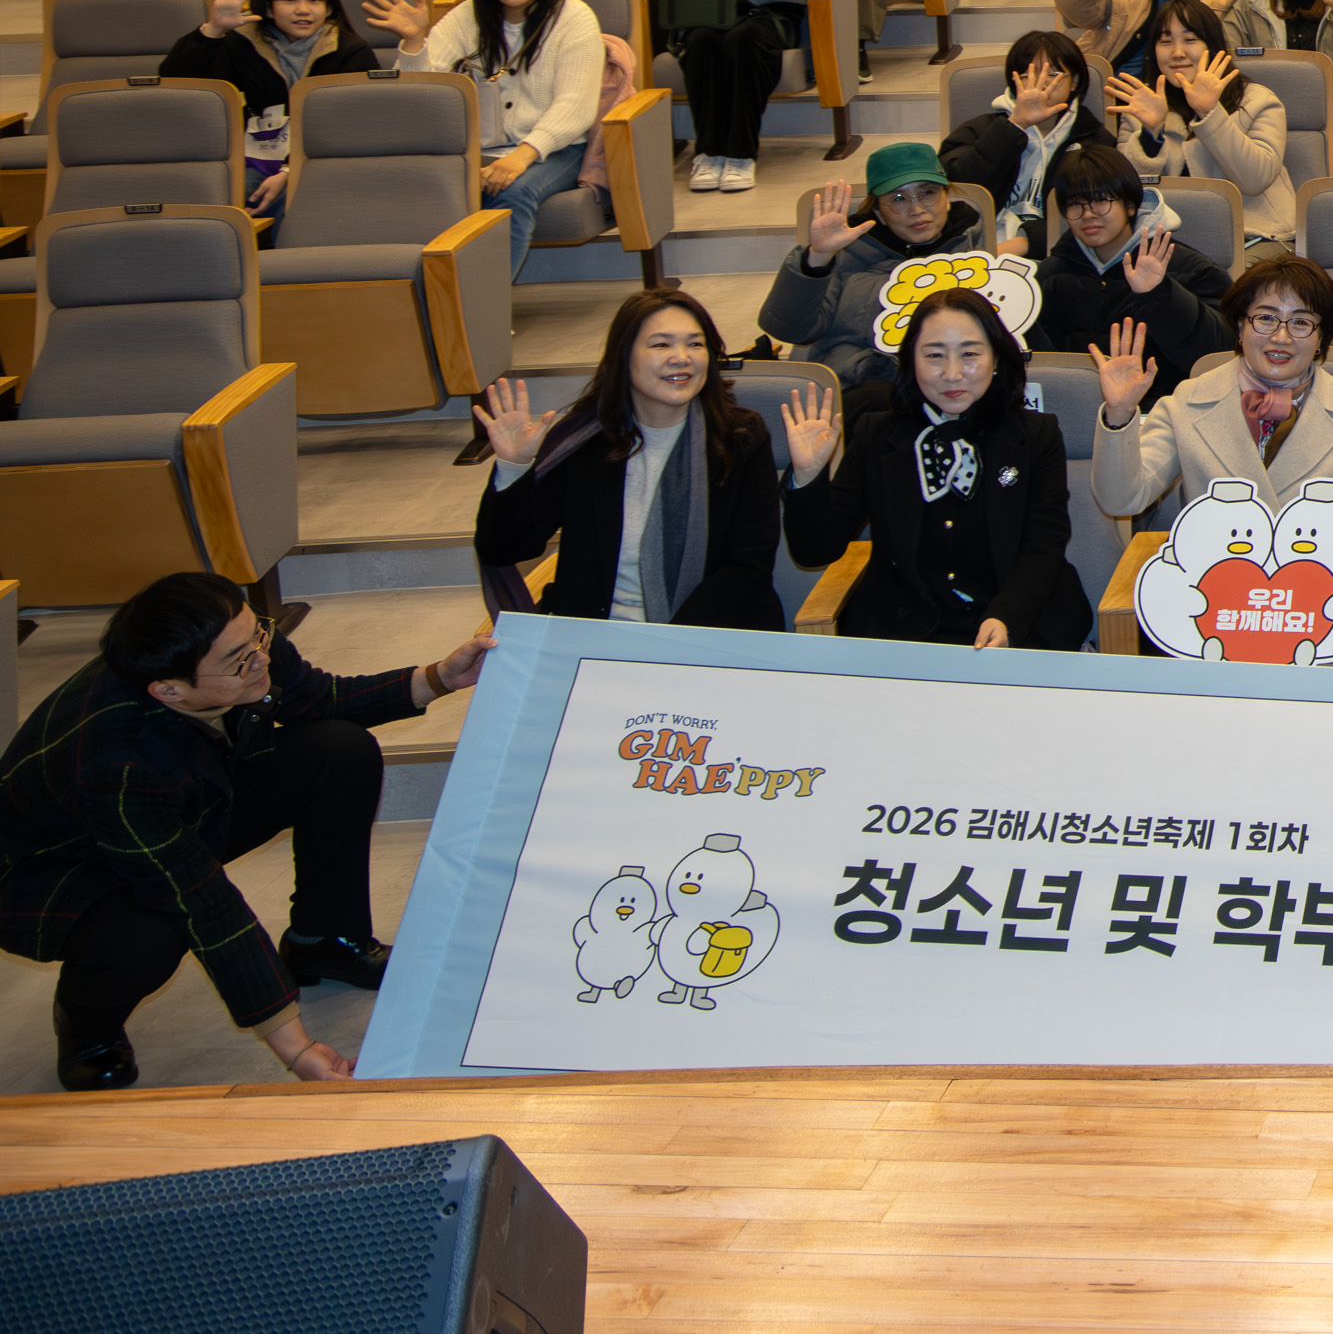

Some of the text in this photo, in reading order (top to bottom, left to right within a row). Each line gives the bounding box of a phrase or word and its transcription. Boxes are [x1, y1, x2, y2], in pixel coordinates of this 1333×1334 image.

[1247, 588, 1294, 611] 우리
[1215, 609, 1316, 633] 함께해요!
[624, 712, 719, 732] DON'T WORRY,
[618, 728, 713, 766] GIM
[861, 803, 1310, 855] 2026 김해시청소년축제 1회차
[832, 858, 1083, 954] 청소년
[1104, 873, 1188, 958] 및
